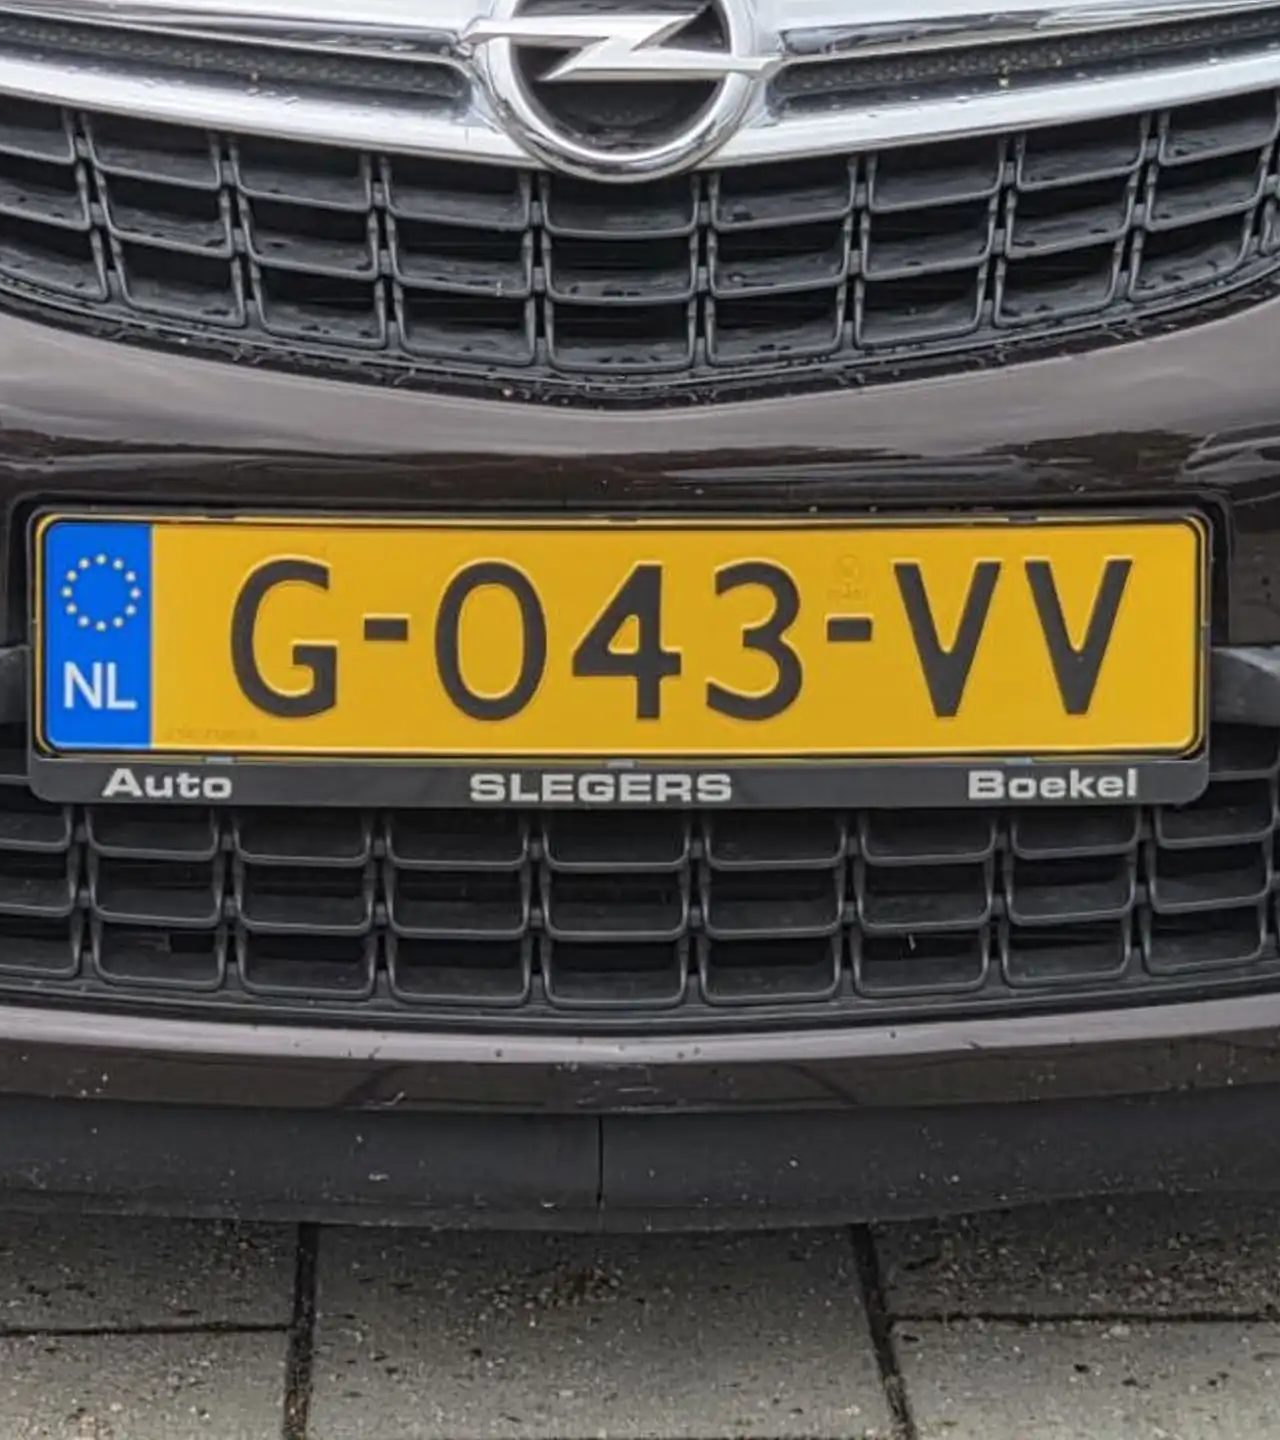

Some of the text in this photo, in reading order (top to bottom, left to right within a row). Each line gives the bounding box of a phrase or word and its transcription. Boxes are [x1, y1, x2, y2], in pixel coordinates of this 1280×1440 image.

[63, 555, 1133, 720] NL G-043-VV
[101, 767, 1139, 802] Auto SLEGERS Boekel
